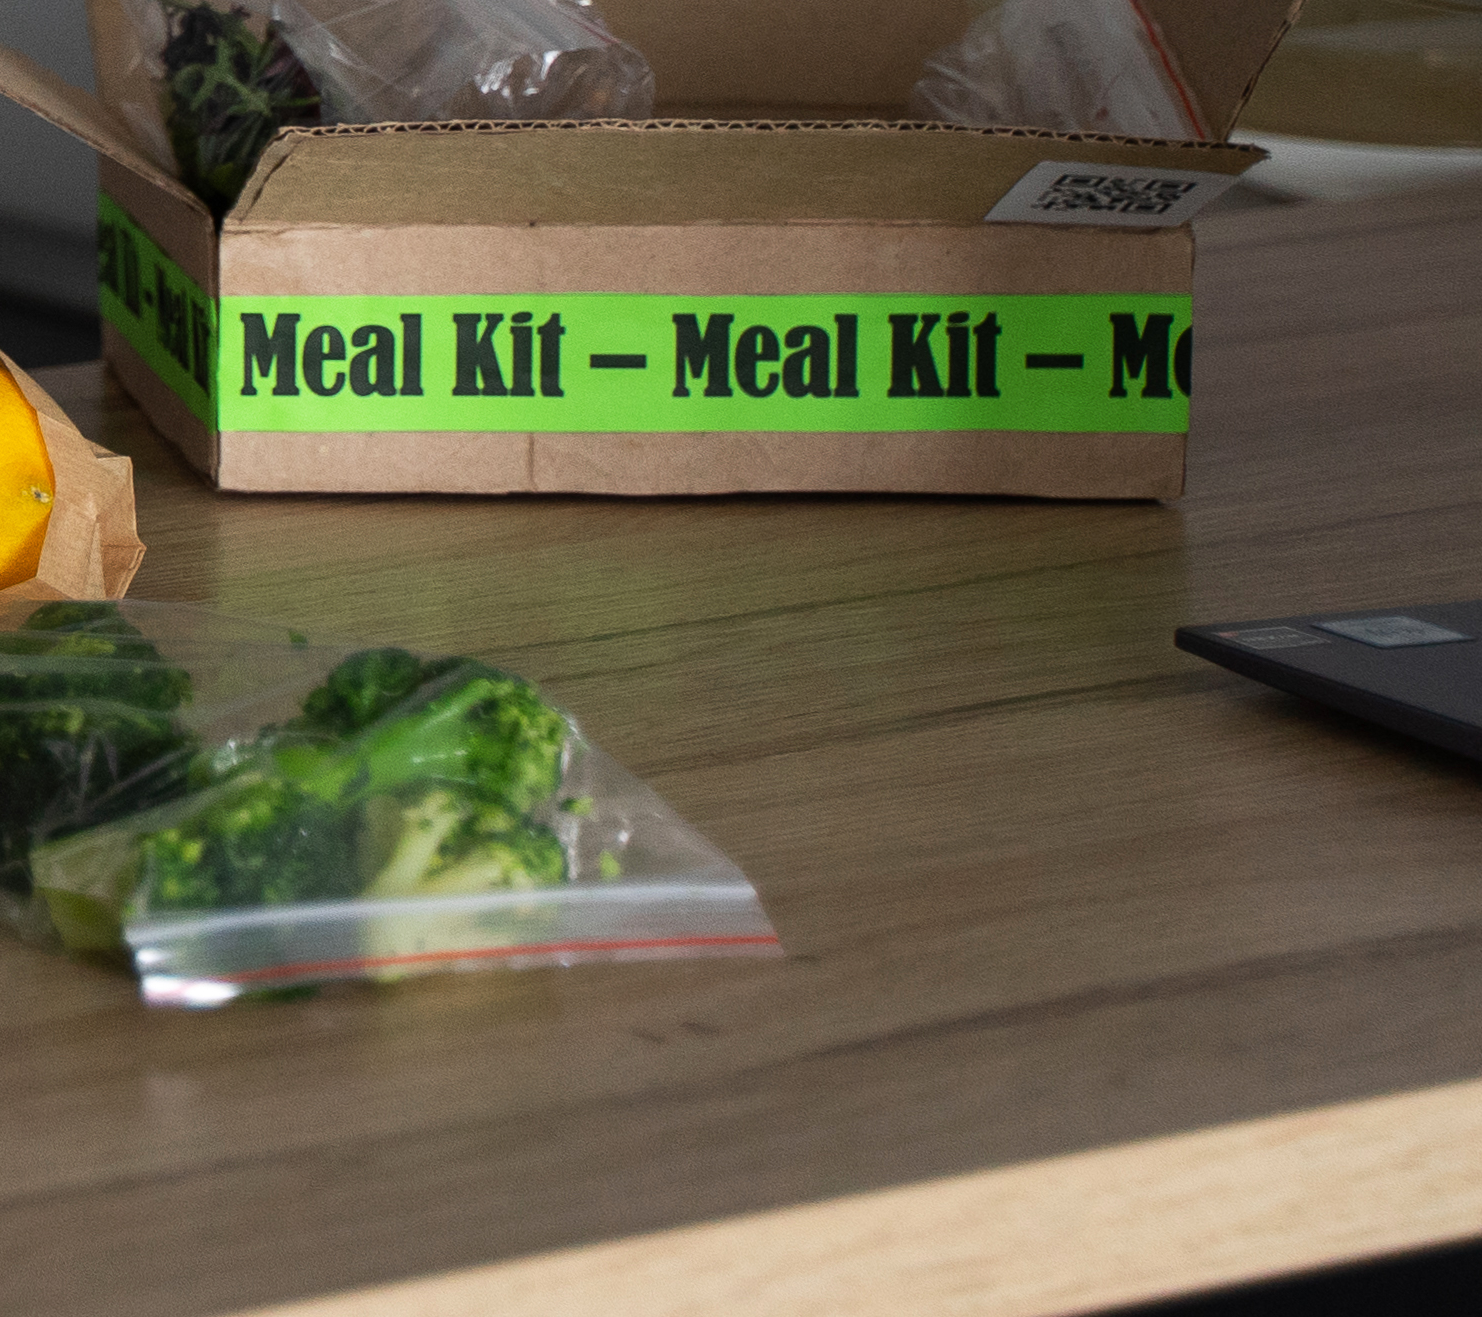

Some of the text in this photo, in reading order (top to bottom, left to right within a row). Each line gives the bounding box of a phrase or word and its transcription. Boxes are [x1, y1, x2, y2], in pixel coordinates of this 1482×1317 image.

[240, 312, 424, 397] Meal
[452, 311, 566, 397] Kit
[671, 312, 860, 399] Meal
[887, 310, 1002, 399] Kit
